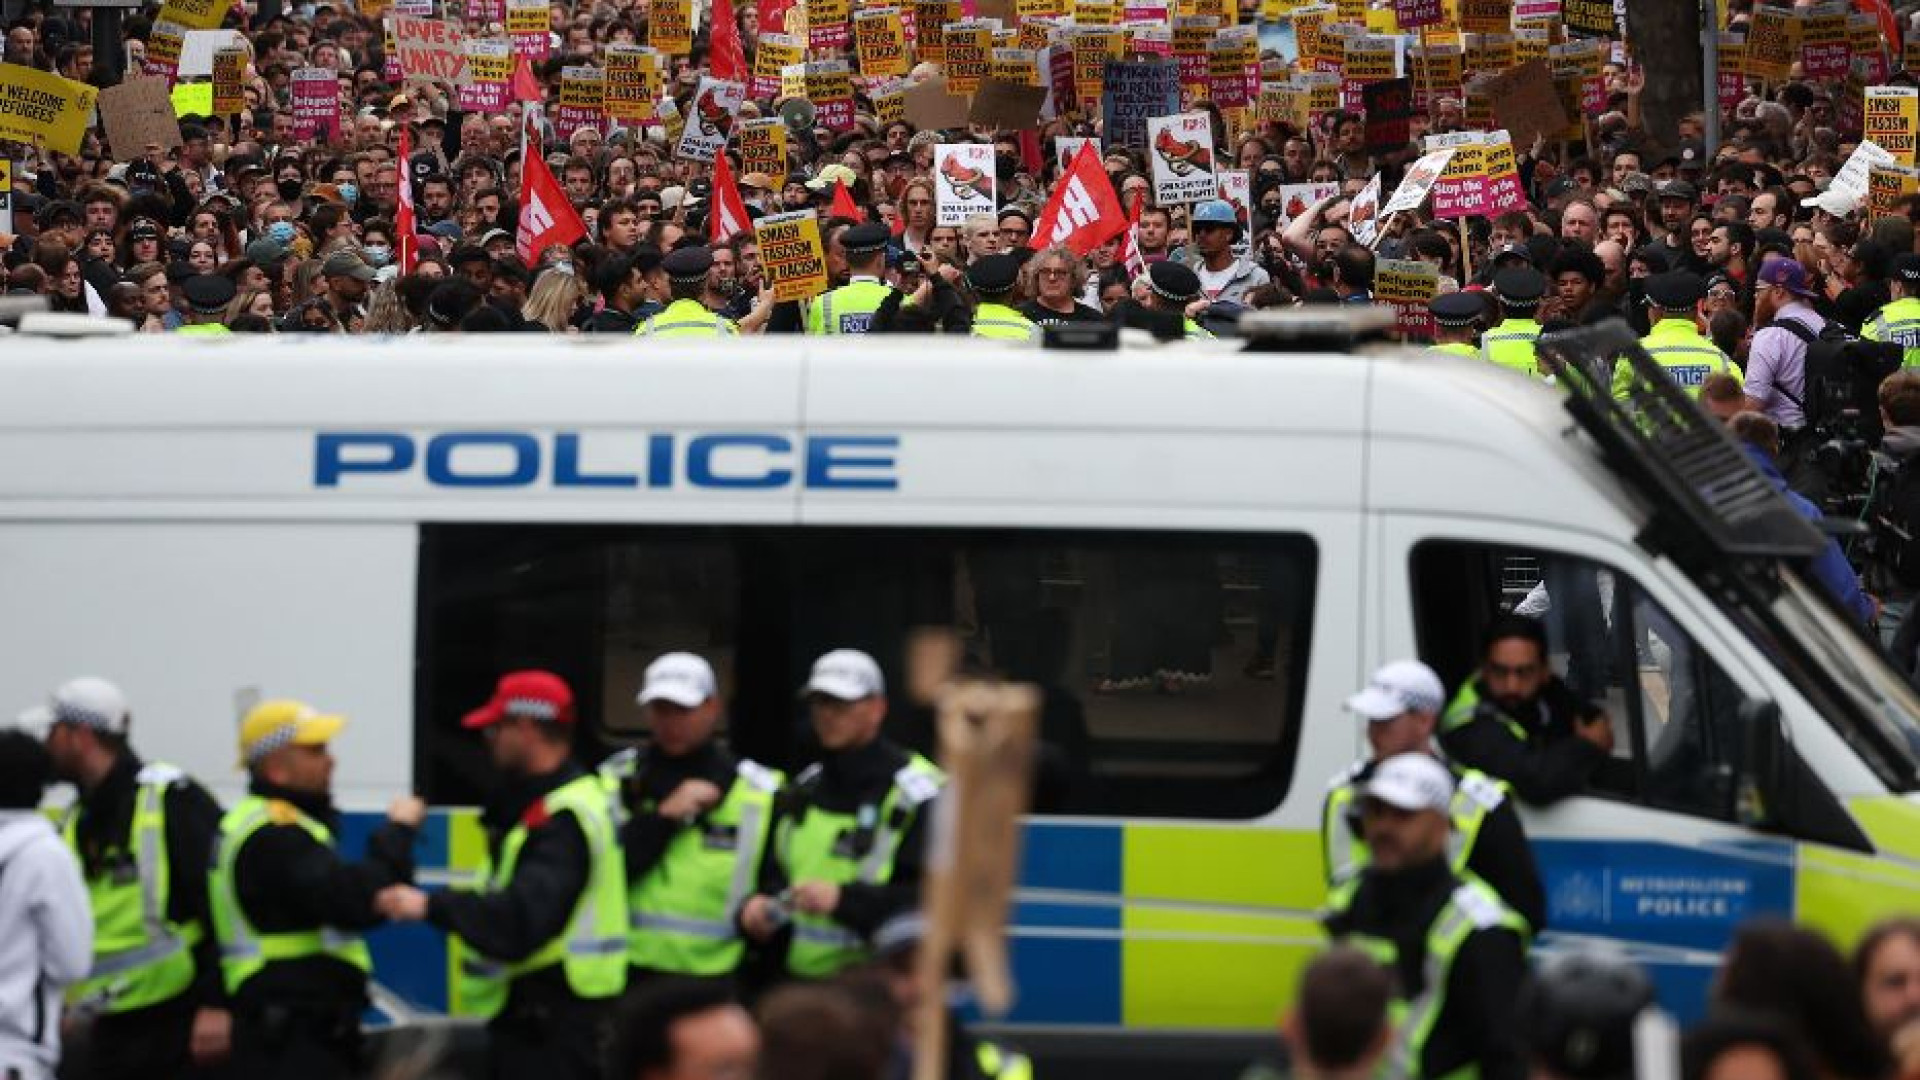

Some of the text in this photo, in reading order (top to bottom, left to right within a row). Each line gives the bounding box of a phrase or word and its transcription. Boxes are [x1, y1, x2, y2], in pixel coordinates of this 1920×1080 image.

[396, 18, 446, 44] LOVE
[946, 33, 977, 46] SMASH
[400, 47, 466, 78] UNITY
[946, 46, 986, 62] FASCISM
[8, 83, 67, 112] WELCOME
[1867, 98, 1900, 114] SMASH
[0, 98, 56, 124] EFUGEES
[1866, 116, 1909, 132] FASCISM
[1433, 180, 1482, 196] Stop the
[1435, 194, 1483, 209] far right
[758, 223, 800, 245] SMASH
[762, 241, 813, 262] FASCISM
[779, 257, 823, 278] RACISM
[1378, 273, 1435, 289] Refugees
[1378, 286, 1431, 299] welcome
[843, 318, 870, 333] POLI
[313, 432, 900, 490] POLICE
[1637, 896, 1729, 917] POLICE
